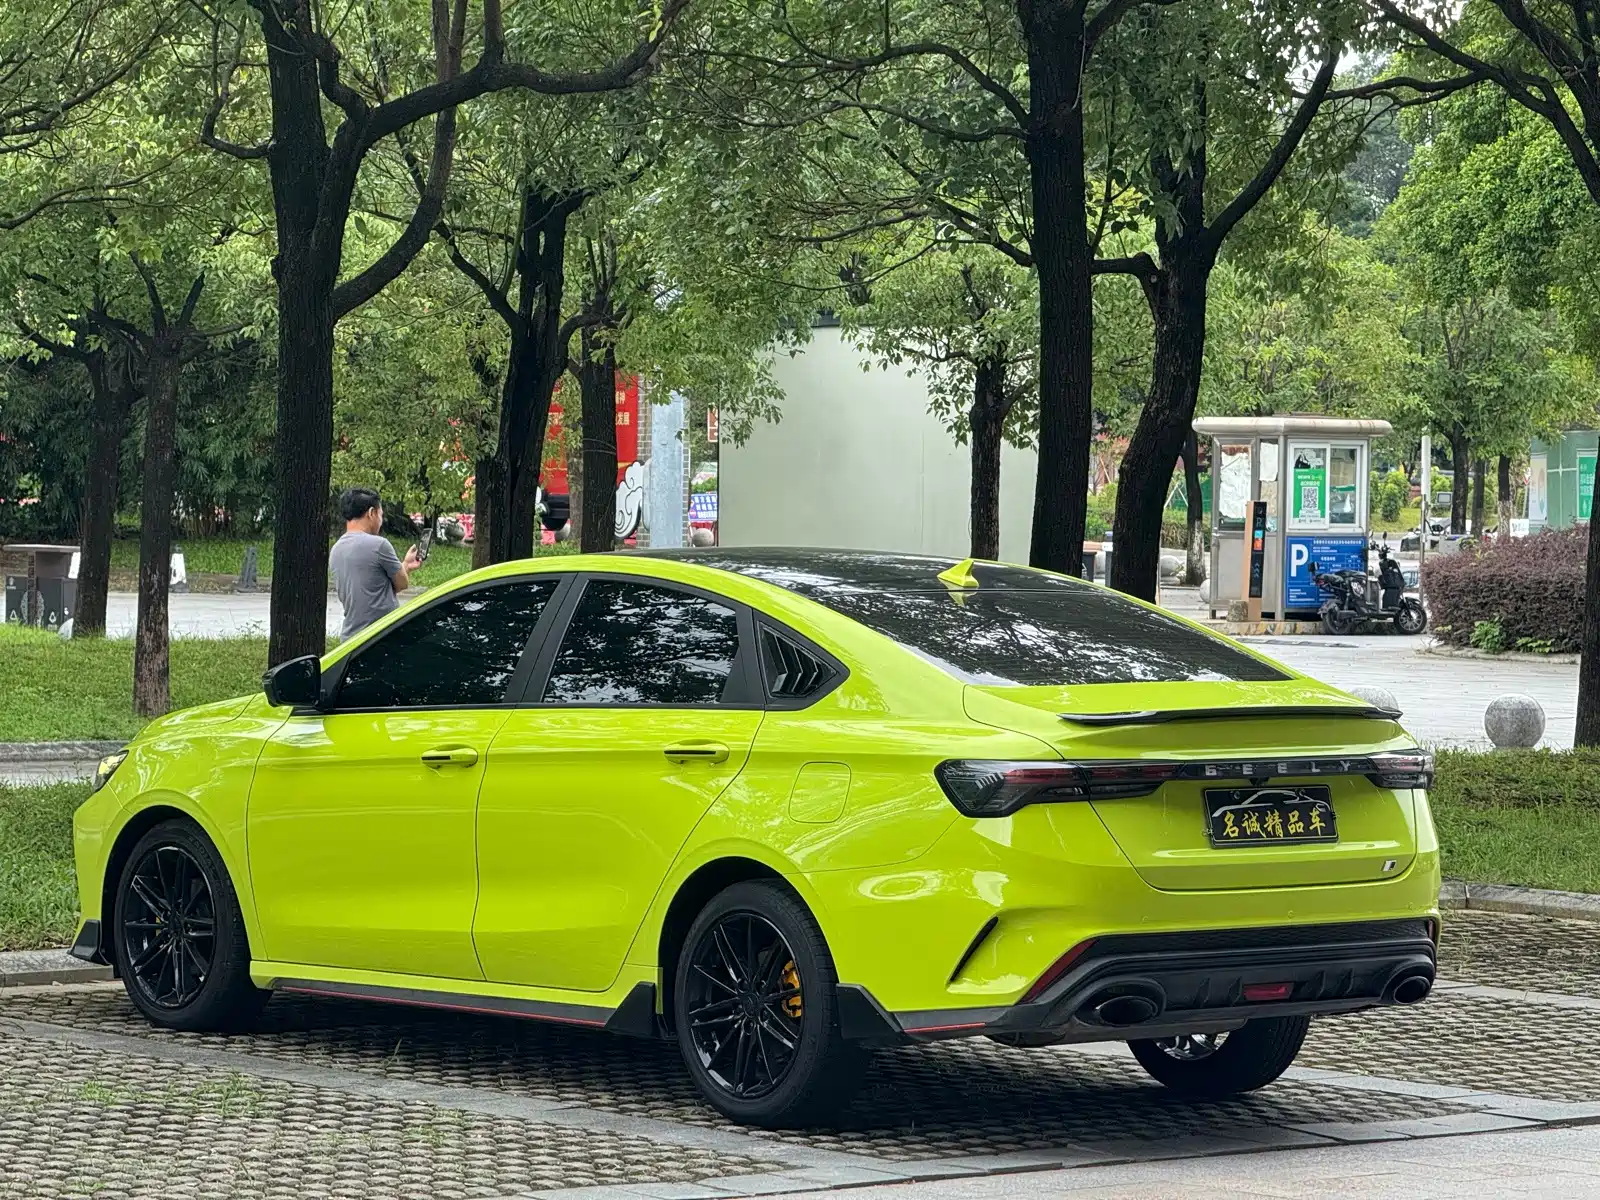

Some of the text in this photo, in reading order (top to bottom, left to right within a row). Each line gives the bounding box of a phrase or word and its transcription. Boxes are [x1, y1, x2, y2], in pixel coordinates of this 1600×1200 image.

[615, 411, 630, 426] 发展
[1290, 544, 1309, 577] P
[1205, 760, 1351, 776] GEELY
[1223, 808, 1326, 838] 名诚精品车
